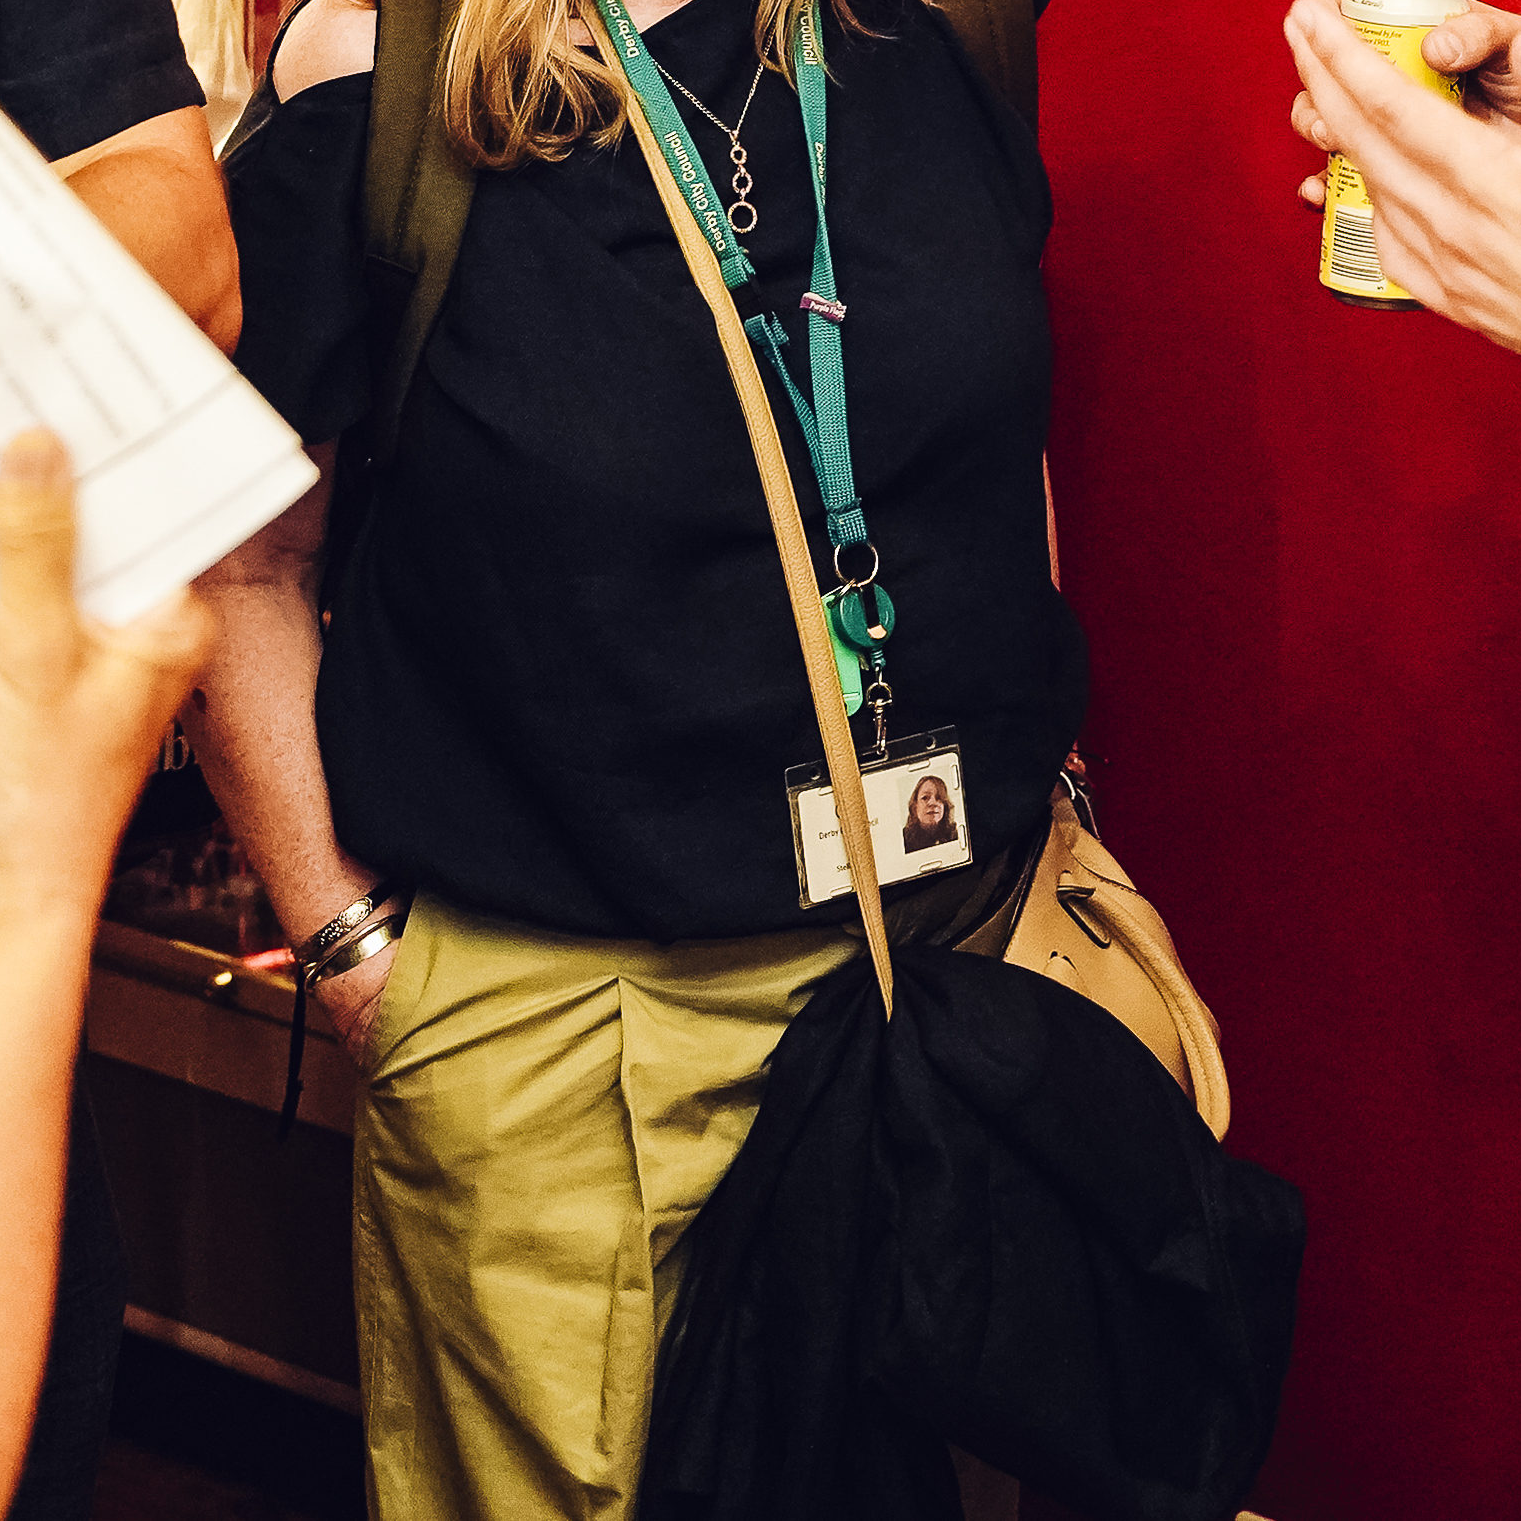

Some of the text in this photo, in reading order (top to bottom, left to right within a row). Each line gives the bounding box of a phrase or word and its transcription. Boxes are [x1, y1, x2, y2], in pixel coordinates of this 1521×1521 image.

[616, 19, 640, 58] Derby
[664, 130, 726, 252] Derby City Council
[818, 828, 840, 840] Derby
